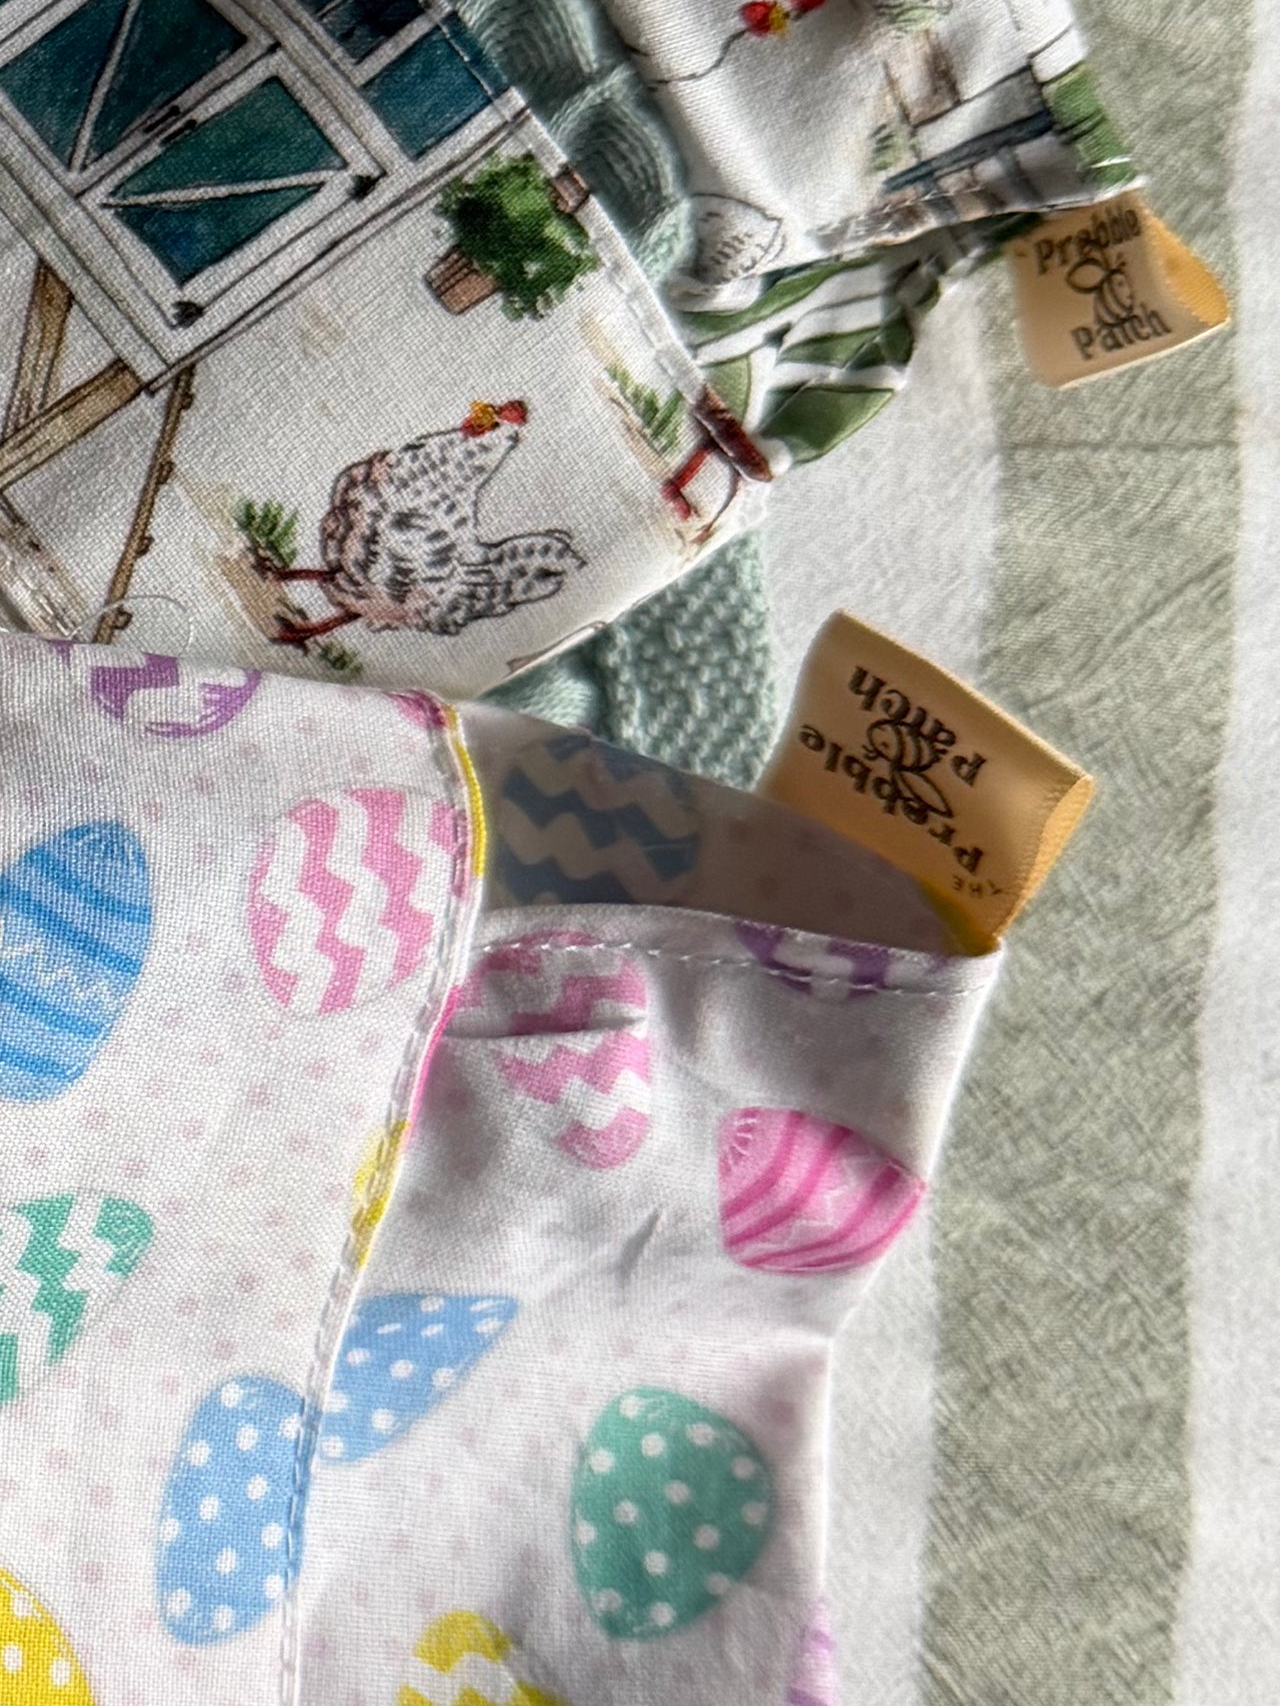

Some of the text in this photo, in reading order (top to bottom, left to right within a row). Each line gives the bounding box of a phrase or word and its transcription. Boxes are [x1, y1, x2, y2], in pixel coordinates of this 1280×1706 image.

[1070, 303, 1172, 361] Patch
[848, 666, 987, 787] Patch
[798, 723, 985, 875] Prebble
[951, 874, 1004, 900] THE
